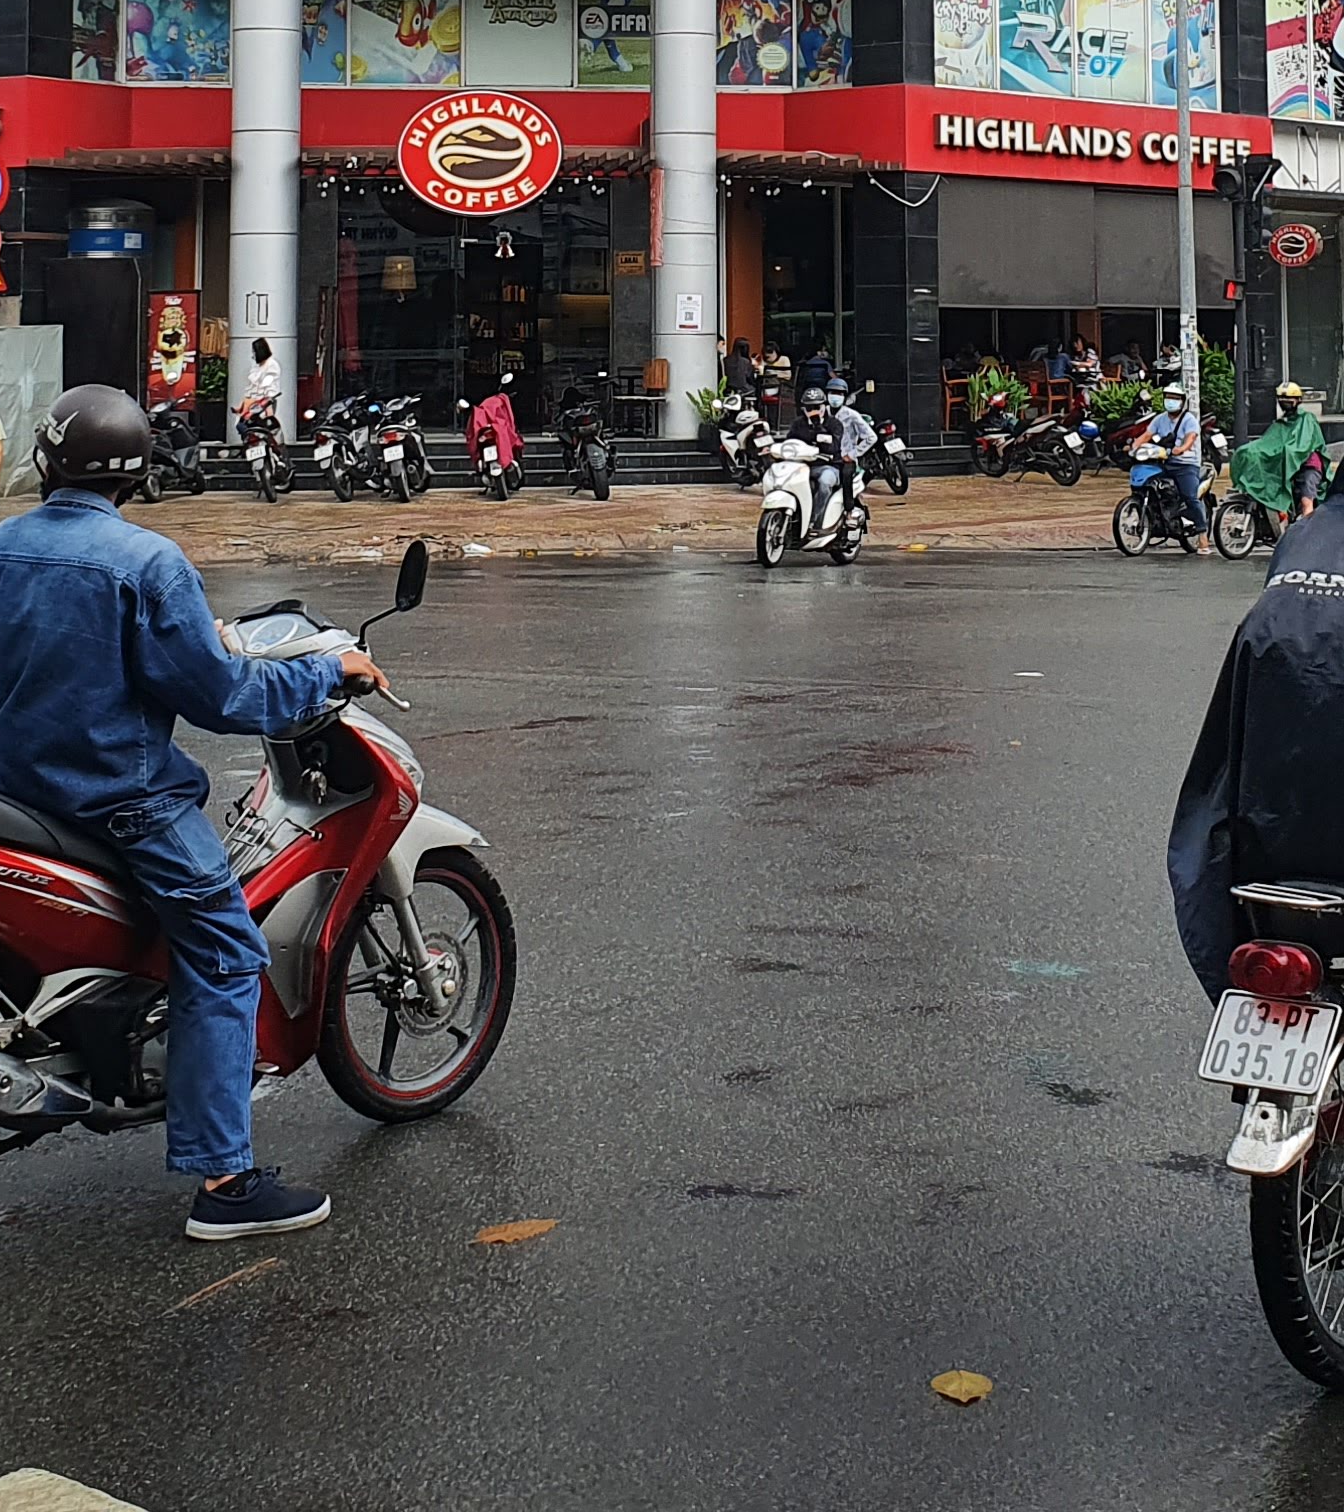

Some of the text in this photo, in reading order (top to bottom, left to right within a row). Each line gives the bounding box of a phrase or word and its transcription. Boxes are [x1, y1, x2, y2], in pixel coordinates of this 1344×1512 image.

[1007, 9, 1130, 74] RACE
[1088, 54, 1129, 79] 07
[408, 97, 553, 148] HIGHLANDS
[938, 113, 1133, 159] HIGHLANDS
[425, 176, 538, 208] COFFEE
[1210, 1038, 1319, 1088] 035.18
